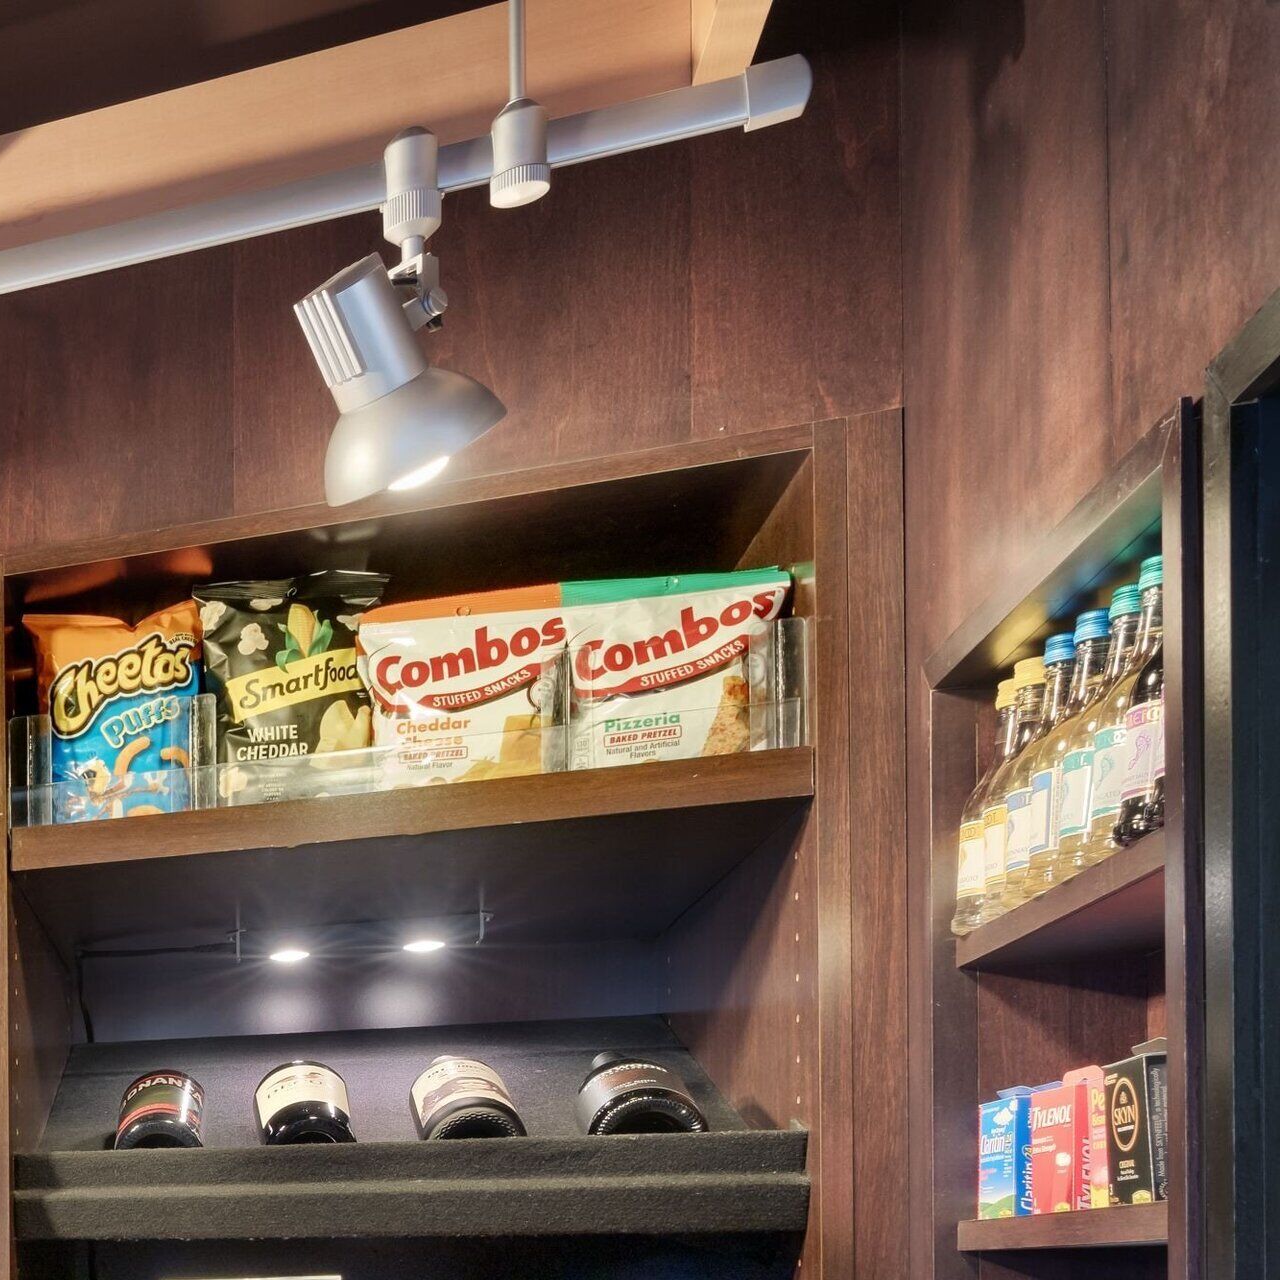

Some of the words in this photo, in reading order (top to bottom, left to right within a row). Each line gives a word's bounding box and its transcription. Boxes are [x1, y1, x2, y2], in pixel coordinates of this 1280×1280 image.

[575, 590, 776, 681] Combos
[376, 616, 567, 695] Combos
[640, 664, 694, 687] STUFFED
[696, 639, 745, 670] SNACKS
[52, 636, 190, 731] Cheetos
[433, 691, 482, 707] STUFFED
[485, 669, 532, 695] SNACKS
[104, 696, 181, 747] Puffs
[396, 717, 471, 735] Cheddar
[604, 713, 680, 733] Pizzeria
[247, 724, 298, 743] WHITE
[609, 734, 639, 744] BAKED
[641, 730, 677, 741] PRETZEL
[236, 742, 308, 761] CHEDDAR
[606, 745, 632, 756] Natural
[634, 743, 648, 751] and
[649, 740, 680, 750] Artificial
[629, 750, 656, 759] Flavors
[432, 761, 453, 769] Flavor
[1032, 1104, 1072, 1132] TYLENOL
[1113, 1104, 1136, 1126] SKYN
